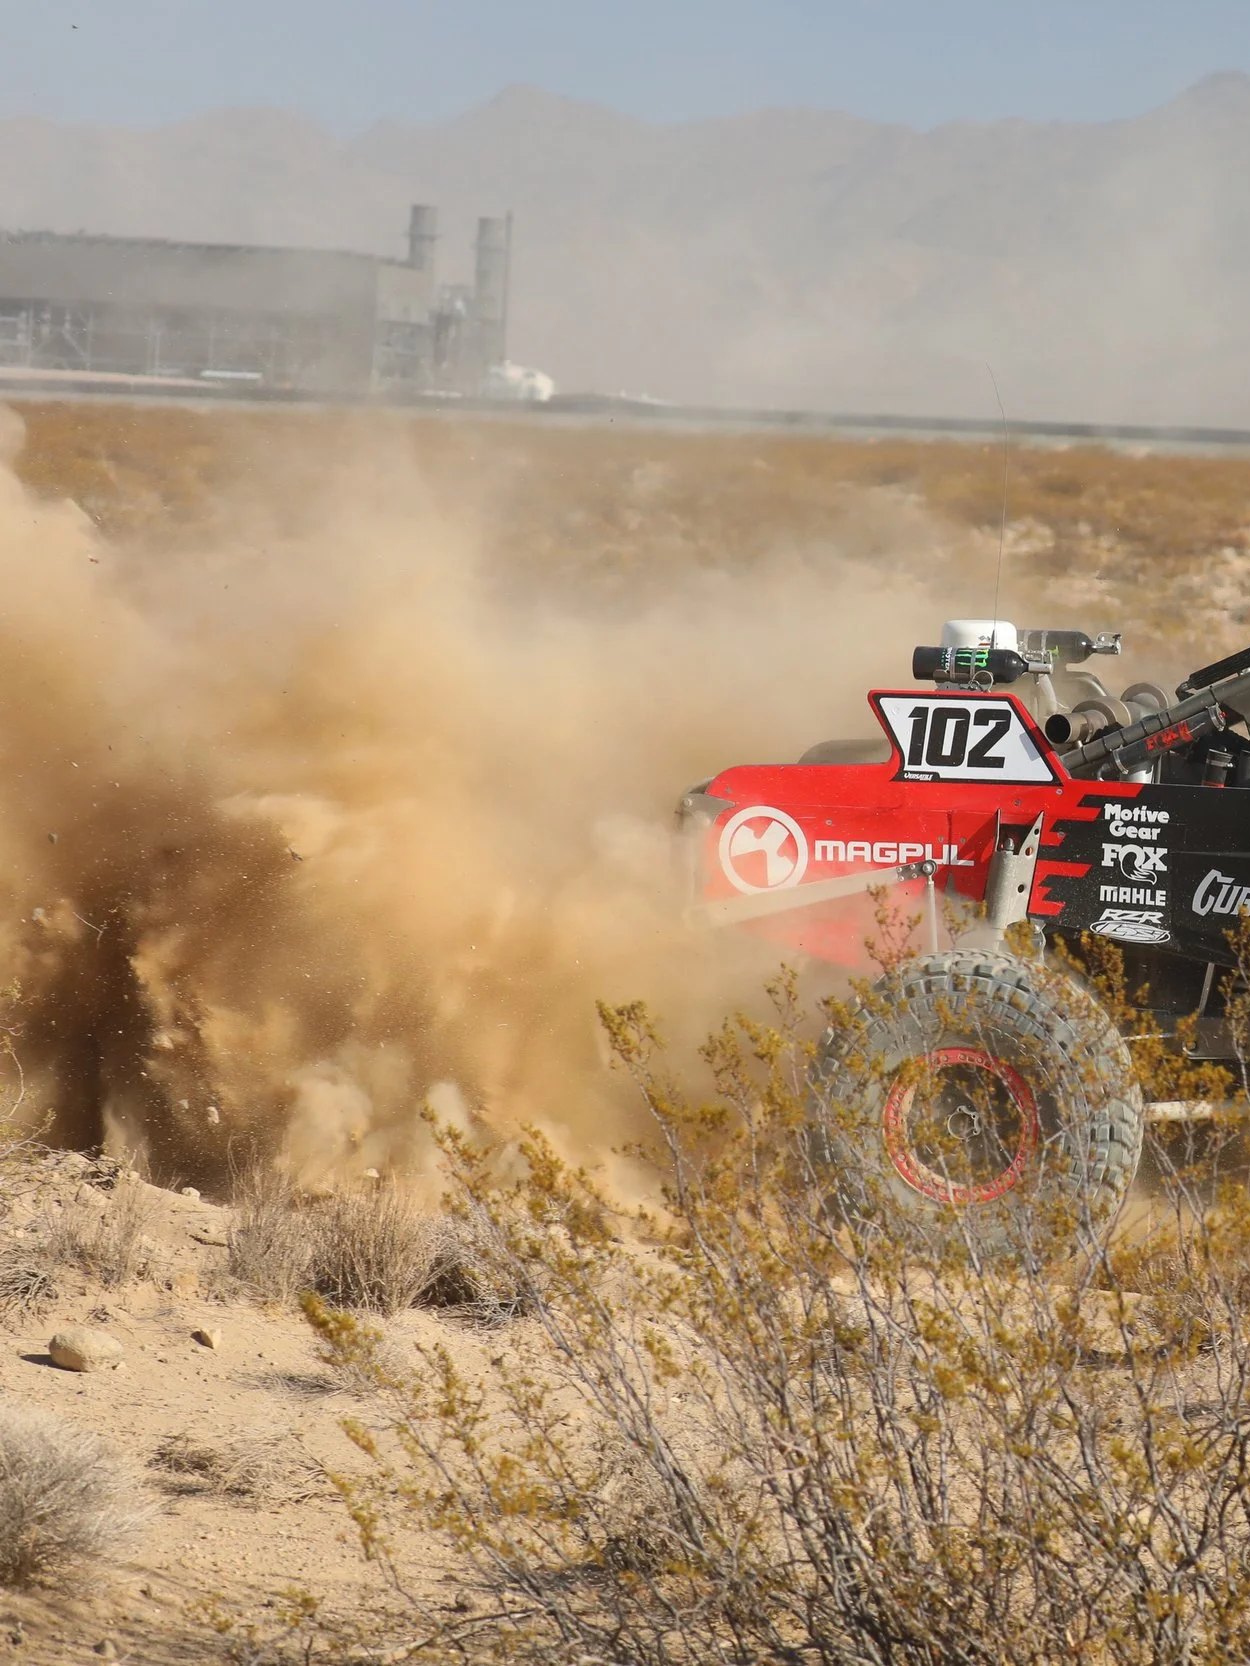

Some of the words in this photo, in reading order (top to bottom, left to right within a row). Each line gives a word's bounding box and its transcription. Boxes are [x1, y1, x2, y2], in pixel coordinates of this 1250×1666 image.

[907, 706, 1012, 769] 102
[1104, 803, 1170, 824] Motive
[1109, 820, 1161, 840] Gear
[814, 839, 975, 866] MAGPUL
[1101, 843, 1168, 886] FOX
[1100, 885, 1167, 906] MAHLE
[1099, 908, 1164, 924] RZR
